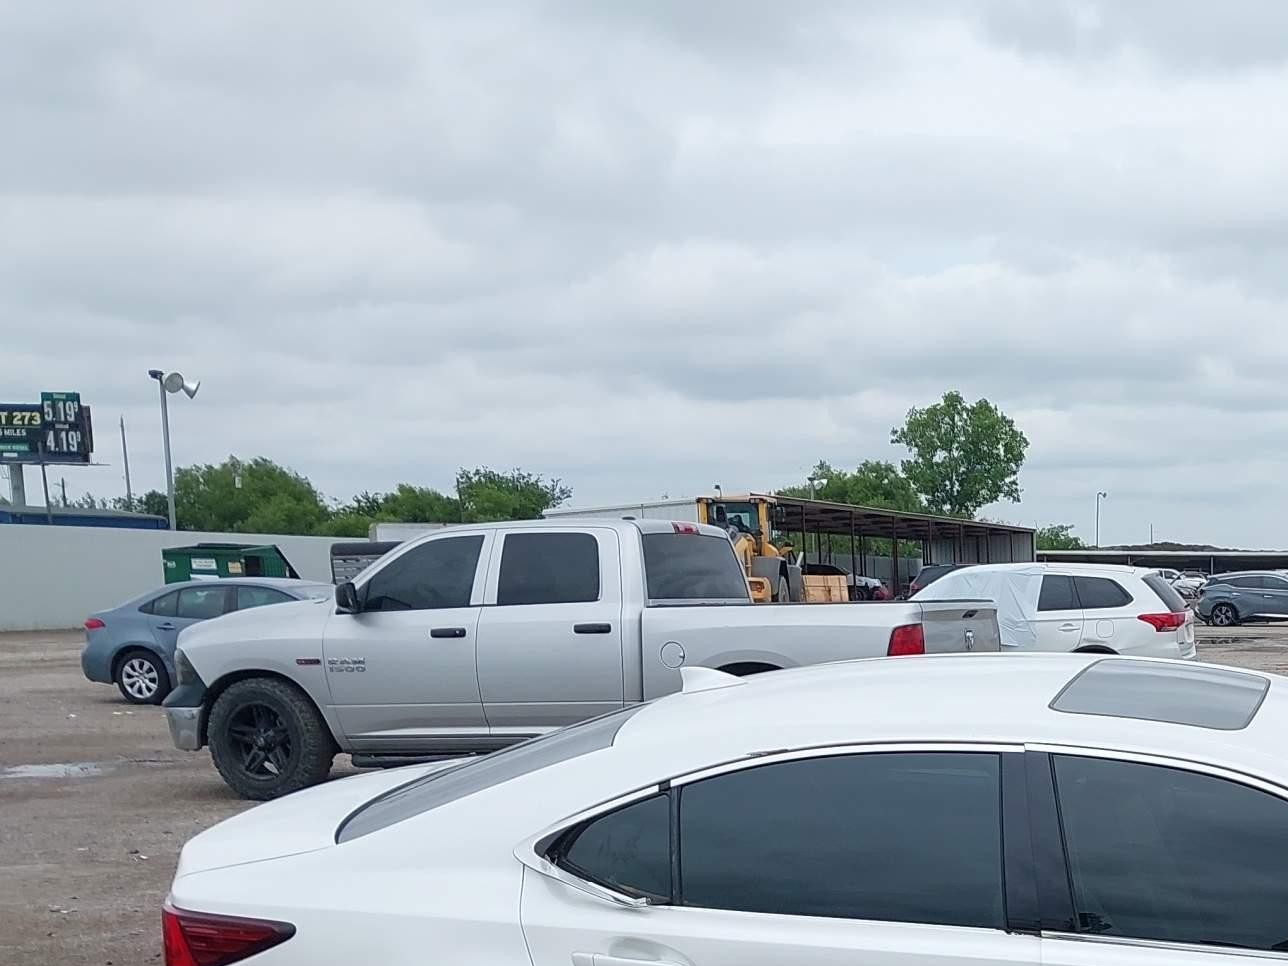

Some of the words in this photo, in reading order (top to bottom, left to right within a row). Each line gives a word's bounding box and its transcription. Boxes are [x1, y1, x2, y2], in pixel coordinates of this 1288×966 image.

[12, 411, 41, 425] 273
[4, 428, 27, 436] MILES
[327, 656, 366, 665] RAM
[328, 665, 367, 673] 1500
